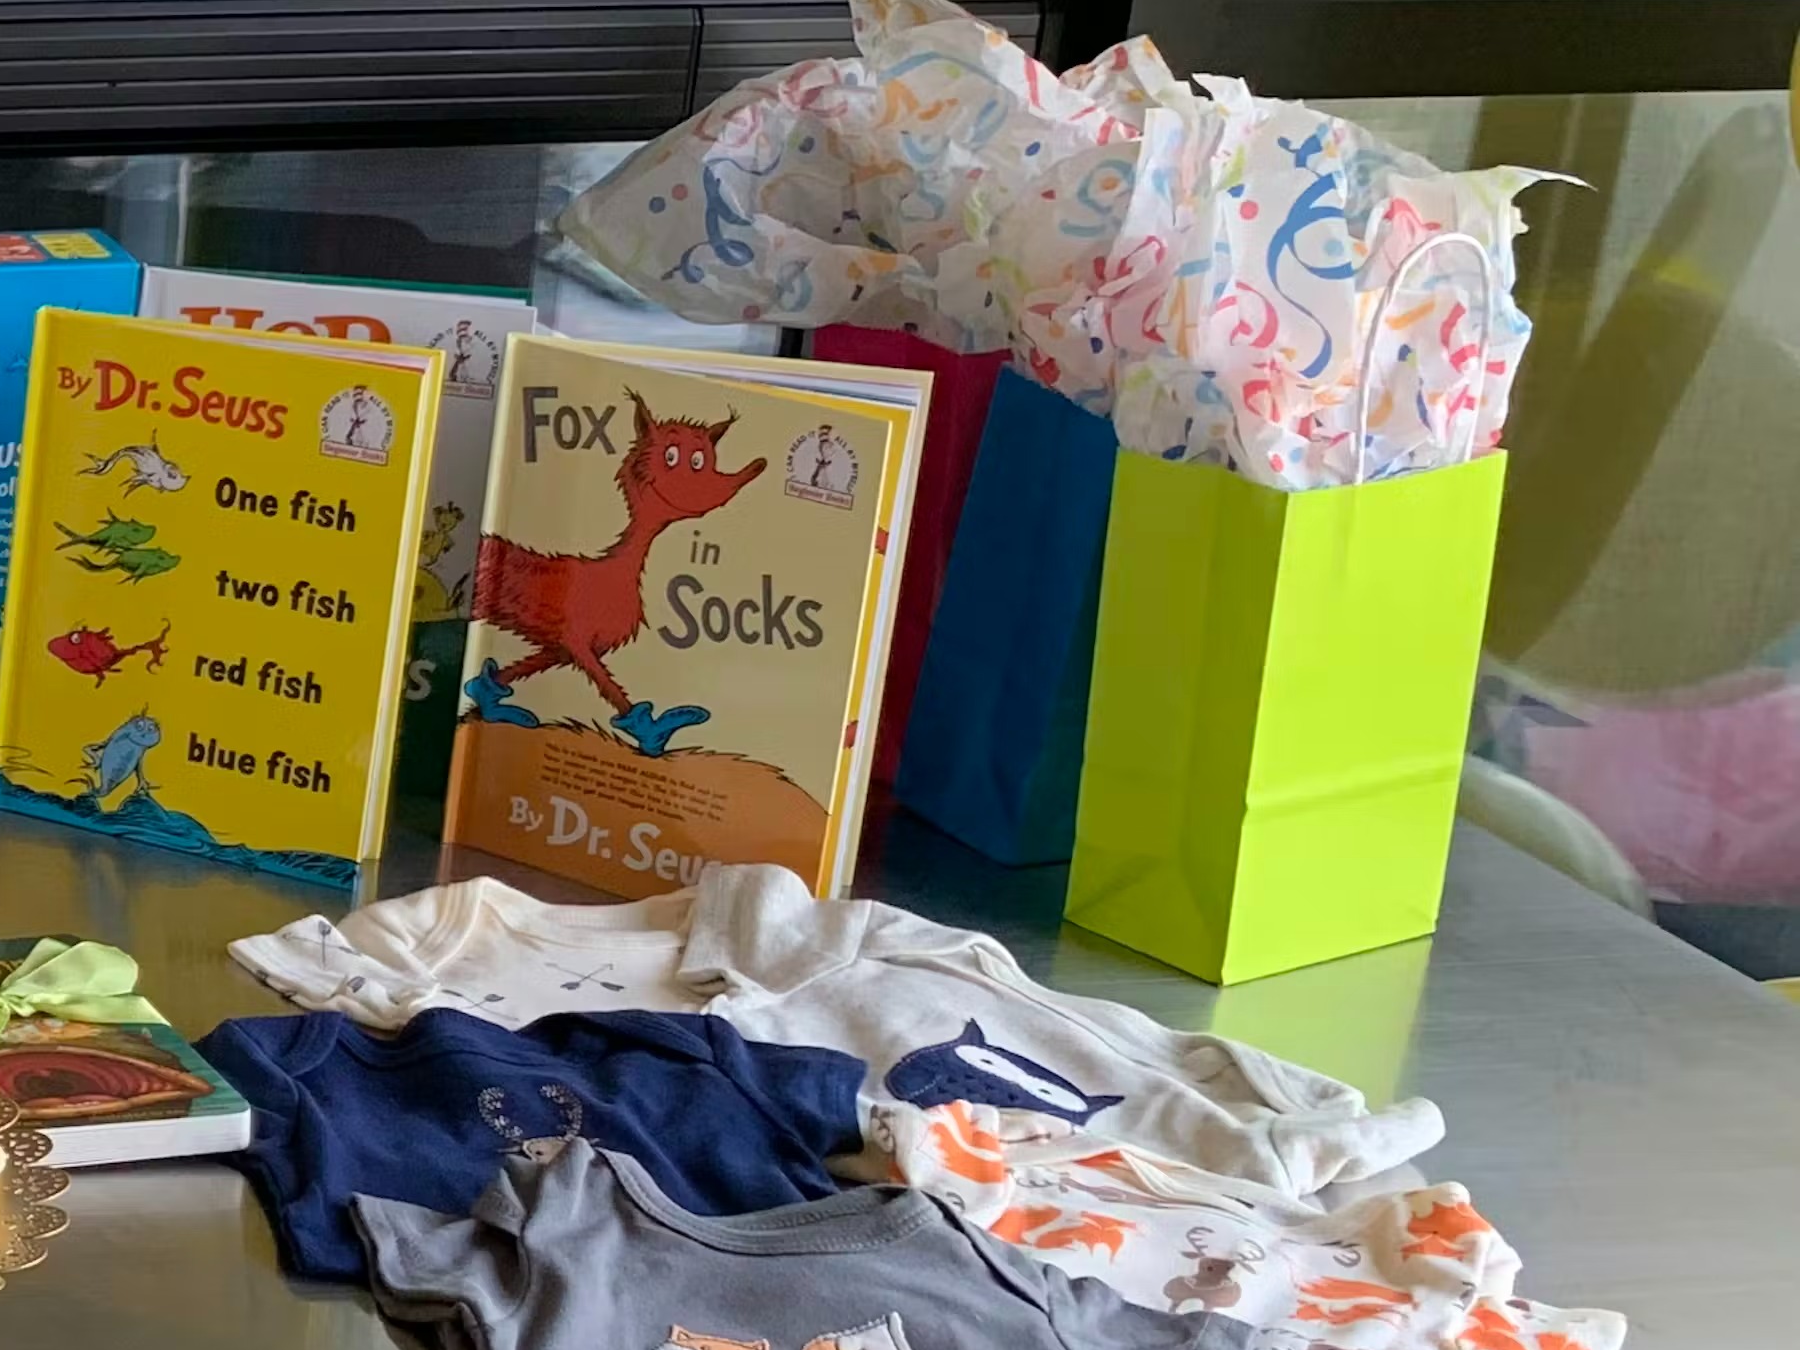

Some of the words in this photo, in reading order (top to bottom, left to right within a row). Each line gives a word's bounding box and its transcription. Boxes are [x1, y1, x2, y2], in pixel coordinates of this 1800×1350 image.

[56, 366, 93, 400] By
[93, 360, 162, 413] Dr.
[167, 366, 289, 440] Seuss
[215, 476, 279, 517] One
[289, 490, 356, 533] fish
[689, 529, 721, 565] in
[215, 569, 280, 608] two
[289, 580, 356, 624] fish
[657, 573, 824, 650] Socks
[193, 654, 248, 687] red
[257, 661, 323, 704] fish
[188, 732, 257, 776] blue
[266, 750, 332, 794] fish
[508, 796, 545, 832] By
[546, 795, 611, 859] Dr.
